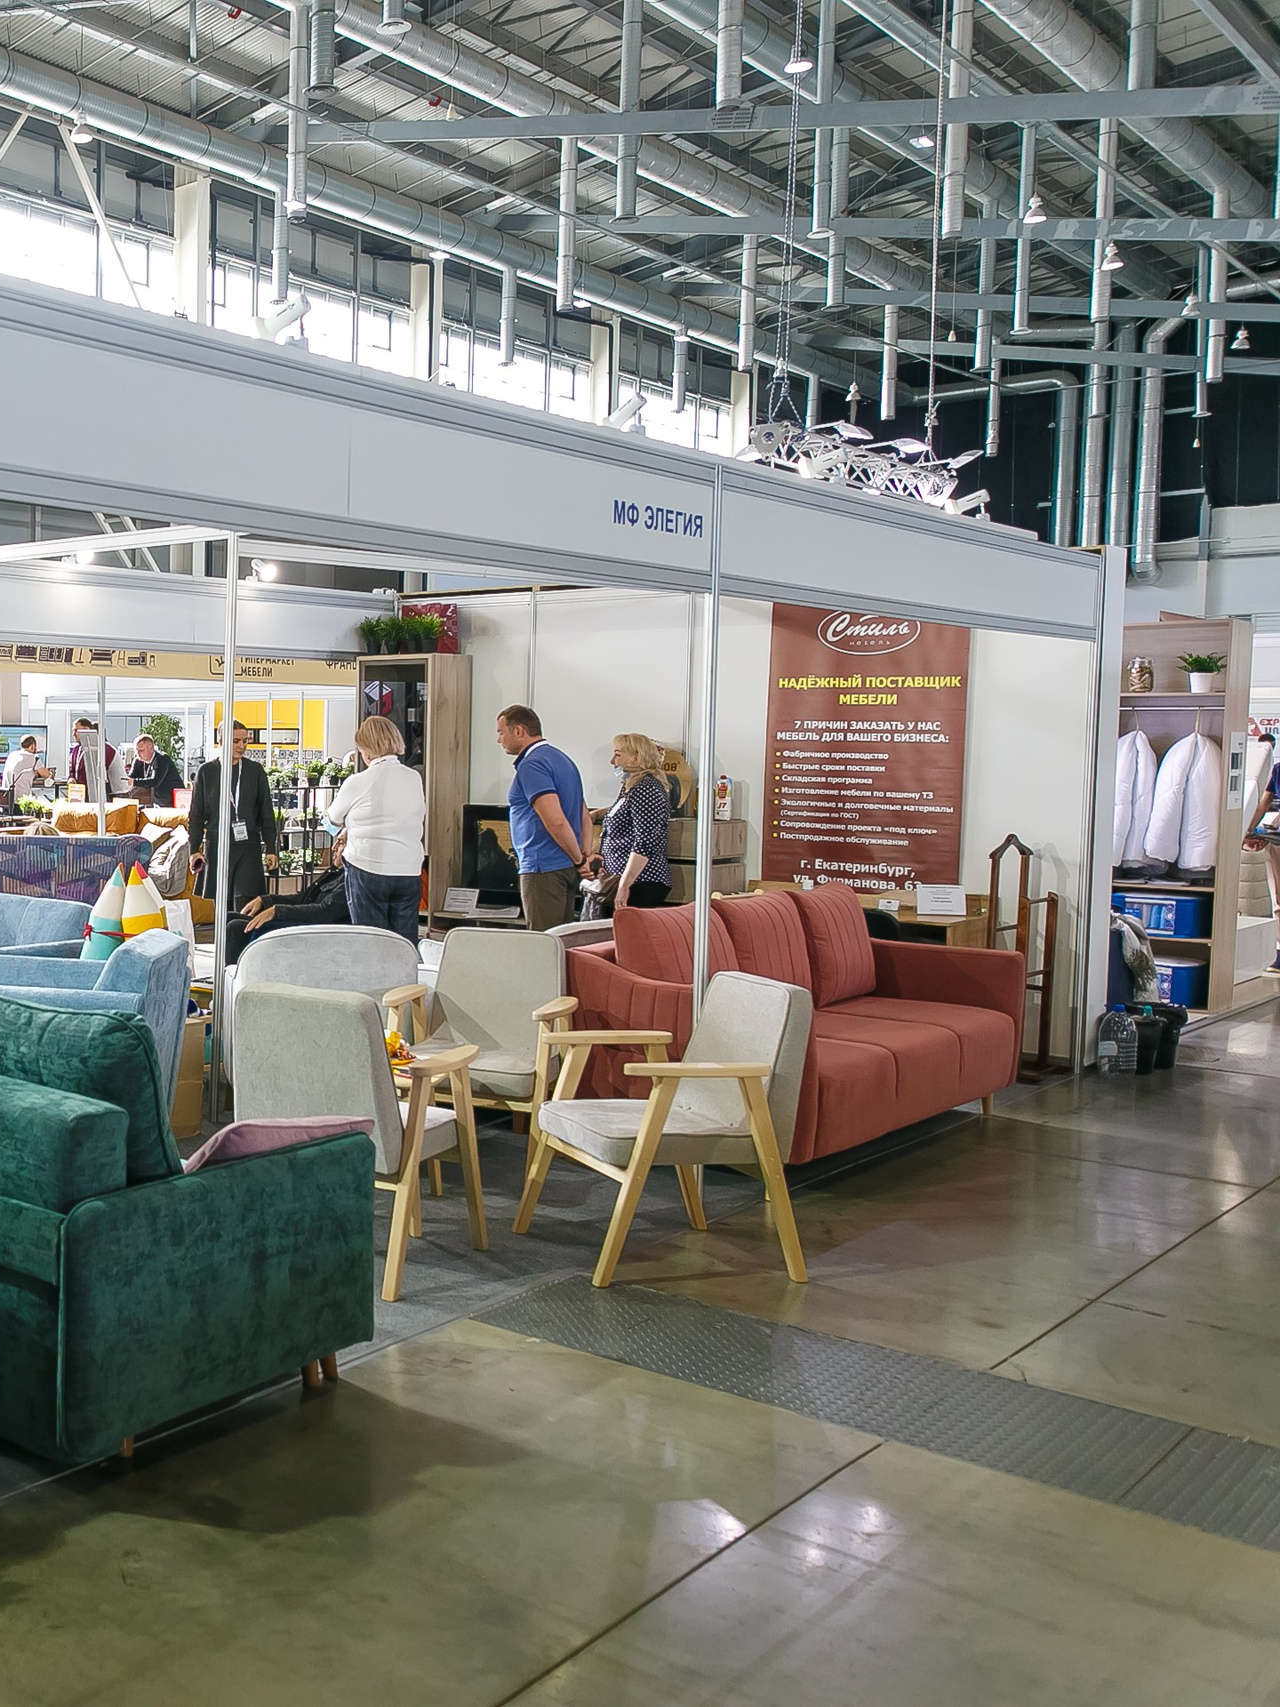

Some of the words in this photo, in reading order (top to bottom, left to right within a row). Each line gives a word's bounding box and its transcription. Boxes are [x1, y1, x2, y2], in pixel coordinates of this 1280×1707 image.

[613, 499, 639, 526] МФ
[644, 505, 703, 538] ЭЛЕГИЯ
[241, 666, 273, 677] МЕБЕЛИ
[778, 674, 862, 691] НАДЁЖНЫЙ
[865, 675, 962, 689] ПОСТАВЩИК
[838, 694, 898, 705] МЕБЕЛИ
[794, 720, 801, 729] 7
[803, 720, 848, 730] ПРИЧИН
[849, 721, 905, 731] ЗАКАЗАТЬ
[907, 721, 915, 731] У
[917, 721, 941, 731] НАС
[776, 731, 820, 741] МЕБЕЛЬ
[821, 732, 844, 742] ДЛЯ
[846, 732, 892, 742] ВАШЕГО
[893, 733, 950, 743] БИЗНЕСА:
[782, 750, 830, 759] Фабричное
[831, 752, 889, 760] производство
[782, 762, 820, 771] Быстрые
[781, 774, 826, 783] Складская
[781, 786, 839, 796] Изготовление
[840, 788, 871, 797] мебели
[885, 791, 920, 800] вашему
[921, 791, 934, 799] ТЗ
[780, 798, 836, 808] Экологичные
[844, 803, 901, 811] долговечные
[903, 805, 954, 813] материалы
[840, 812, 859, 820] ГОСТ)
[780, 820, 846, 830] Сопровождение
[847, 824, 882, 832] проекта
[883, 826, 906, 834] «под
[780, 832, 844, 842] Постпродажное
[846, 836, 909, 846] обслуживание
[800, 859, 811, 868] г.
[814, 858, 916, 878] Екатеринбург,
